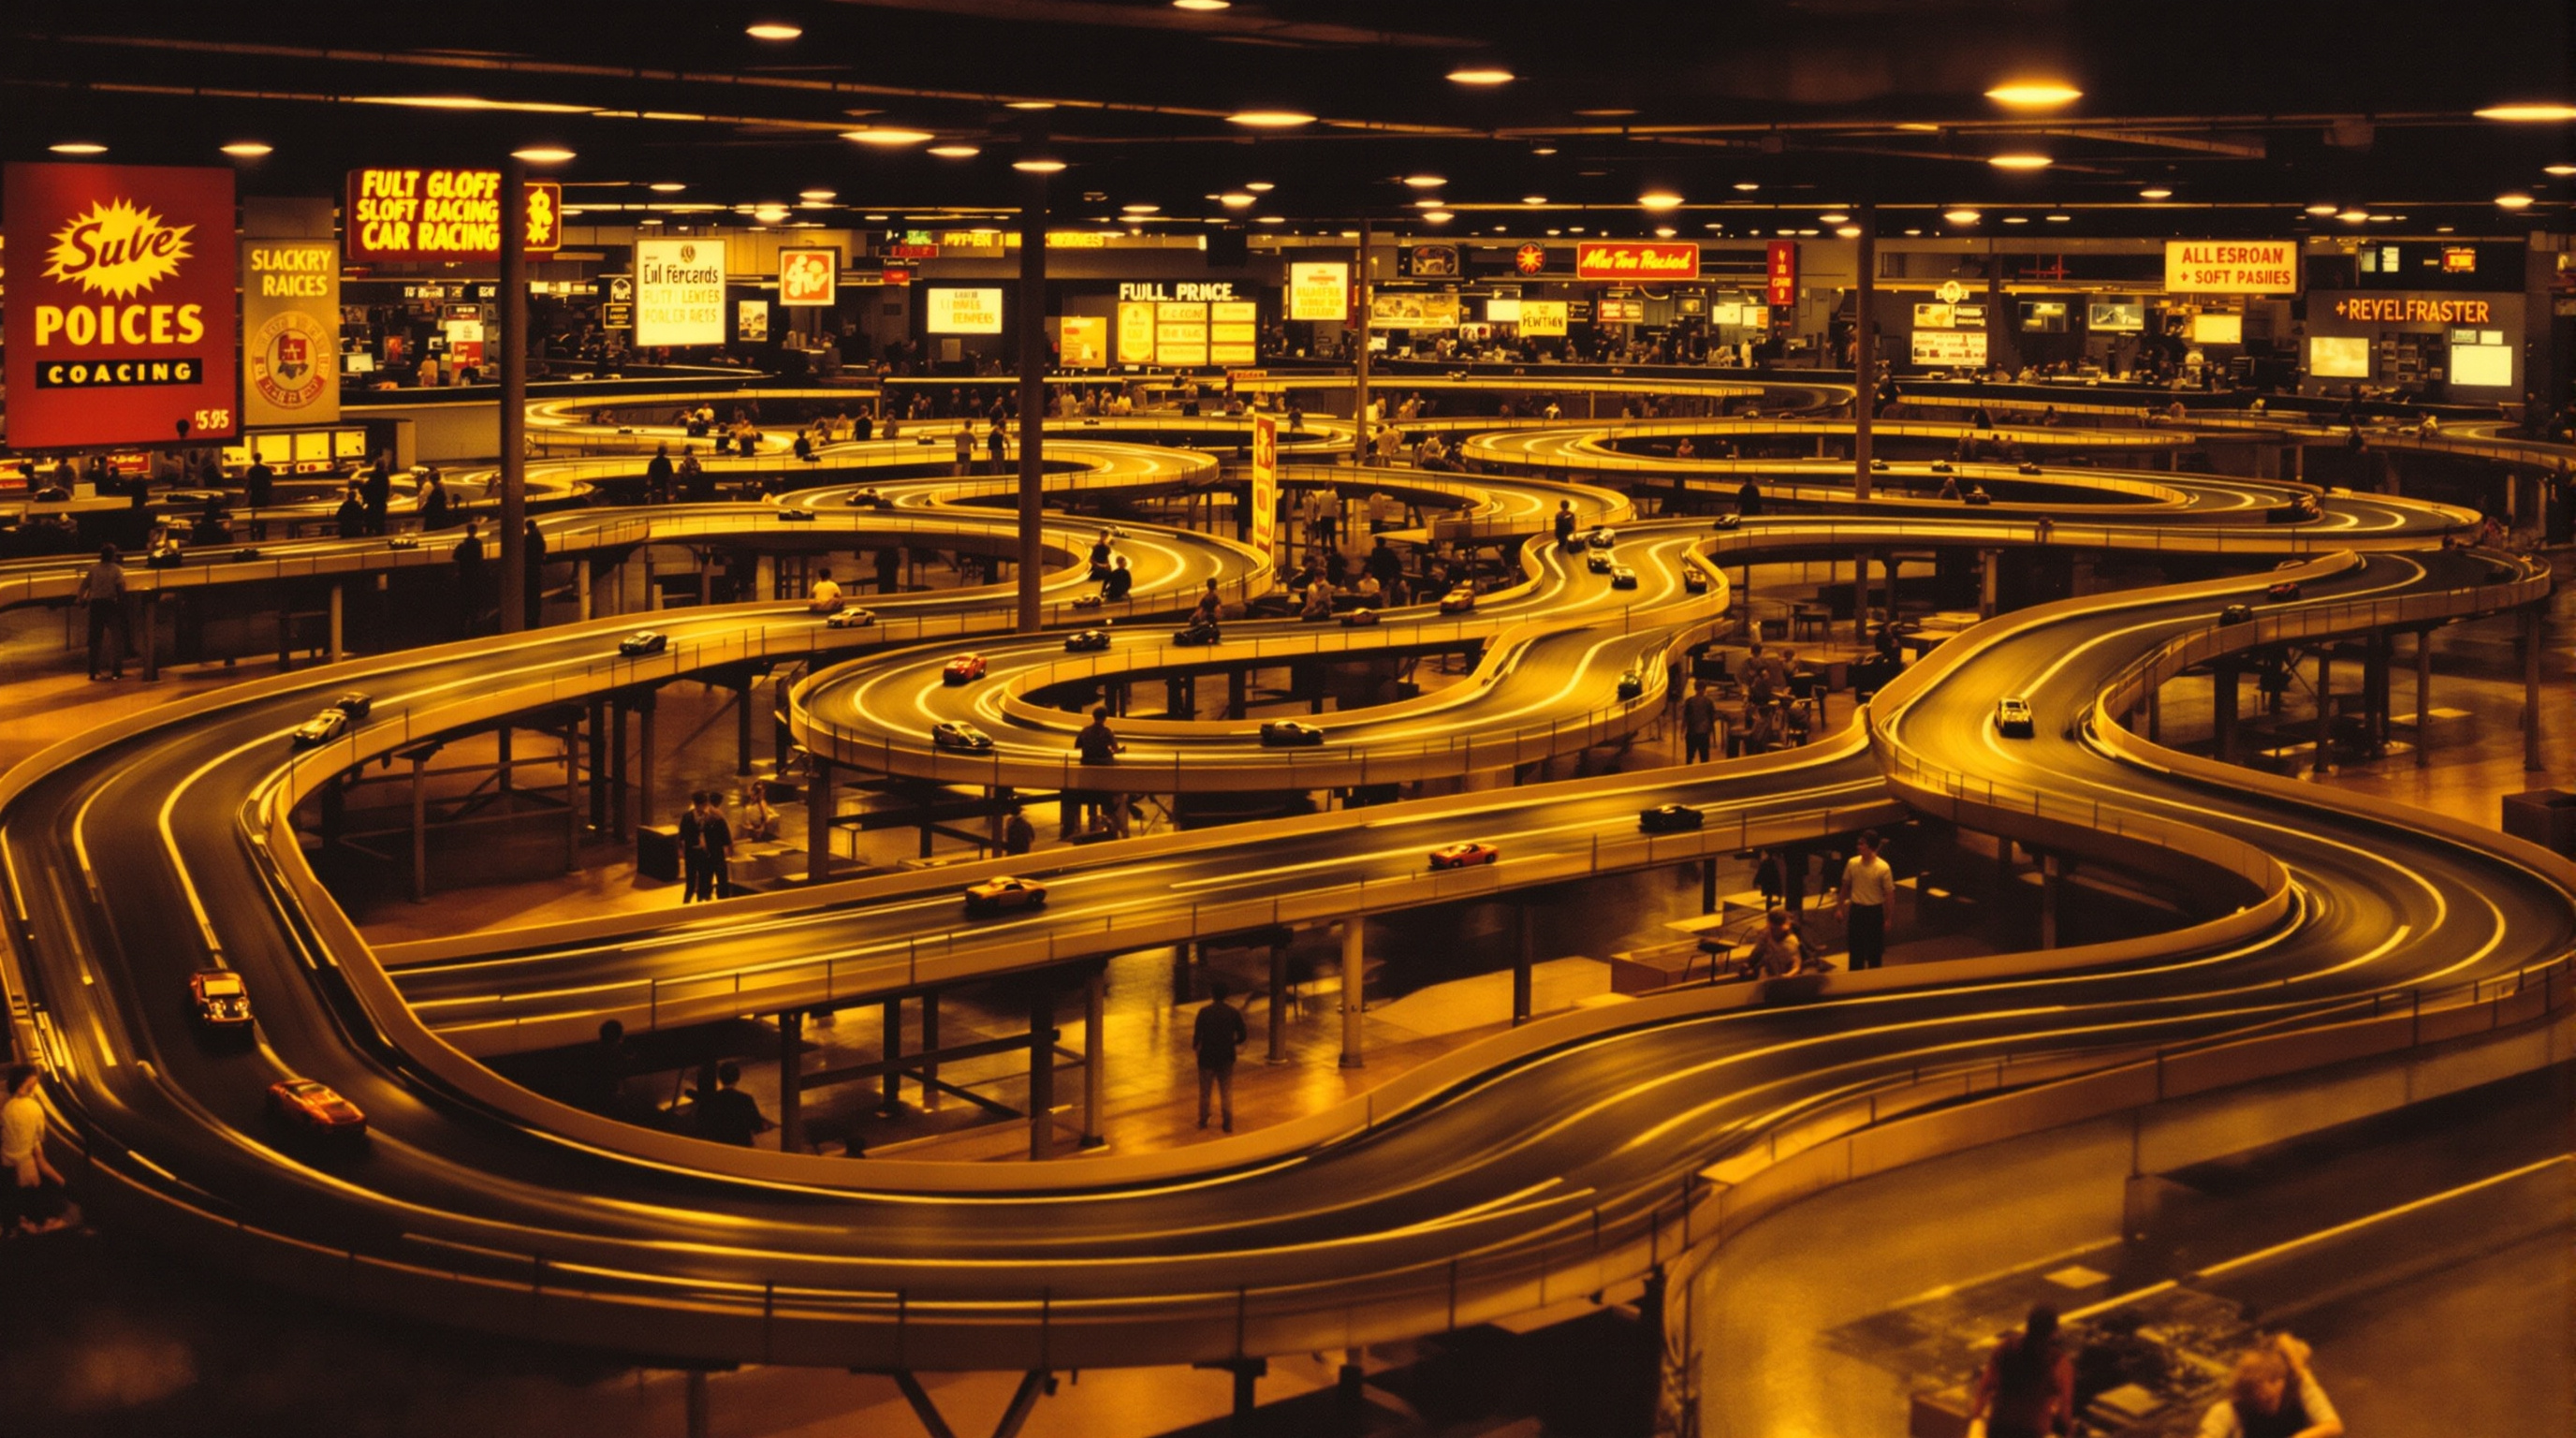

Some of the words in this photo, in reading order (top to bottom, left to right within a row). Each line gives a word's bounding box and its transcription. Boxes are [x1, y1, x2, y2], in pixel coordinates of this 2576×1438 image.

[361, 169, 420, 198] FULT
[426, 171, 502, 199] GLOFF
[356, 198, 419, 222] SLOFT
[423, 198, 499, 222] RACING
[361, 221, 411, 251] CAR
[417, 221, 501, 252] RACING
[251, 249, 332, 271] SLACKRY
[262, 274, 329, 297] RAICES
[2194, 270, 2232, 284] SOFT
[35, 304, 204, 346] POICES
[48, 362, 192, 384] COACING
